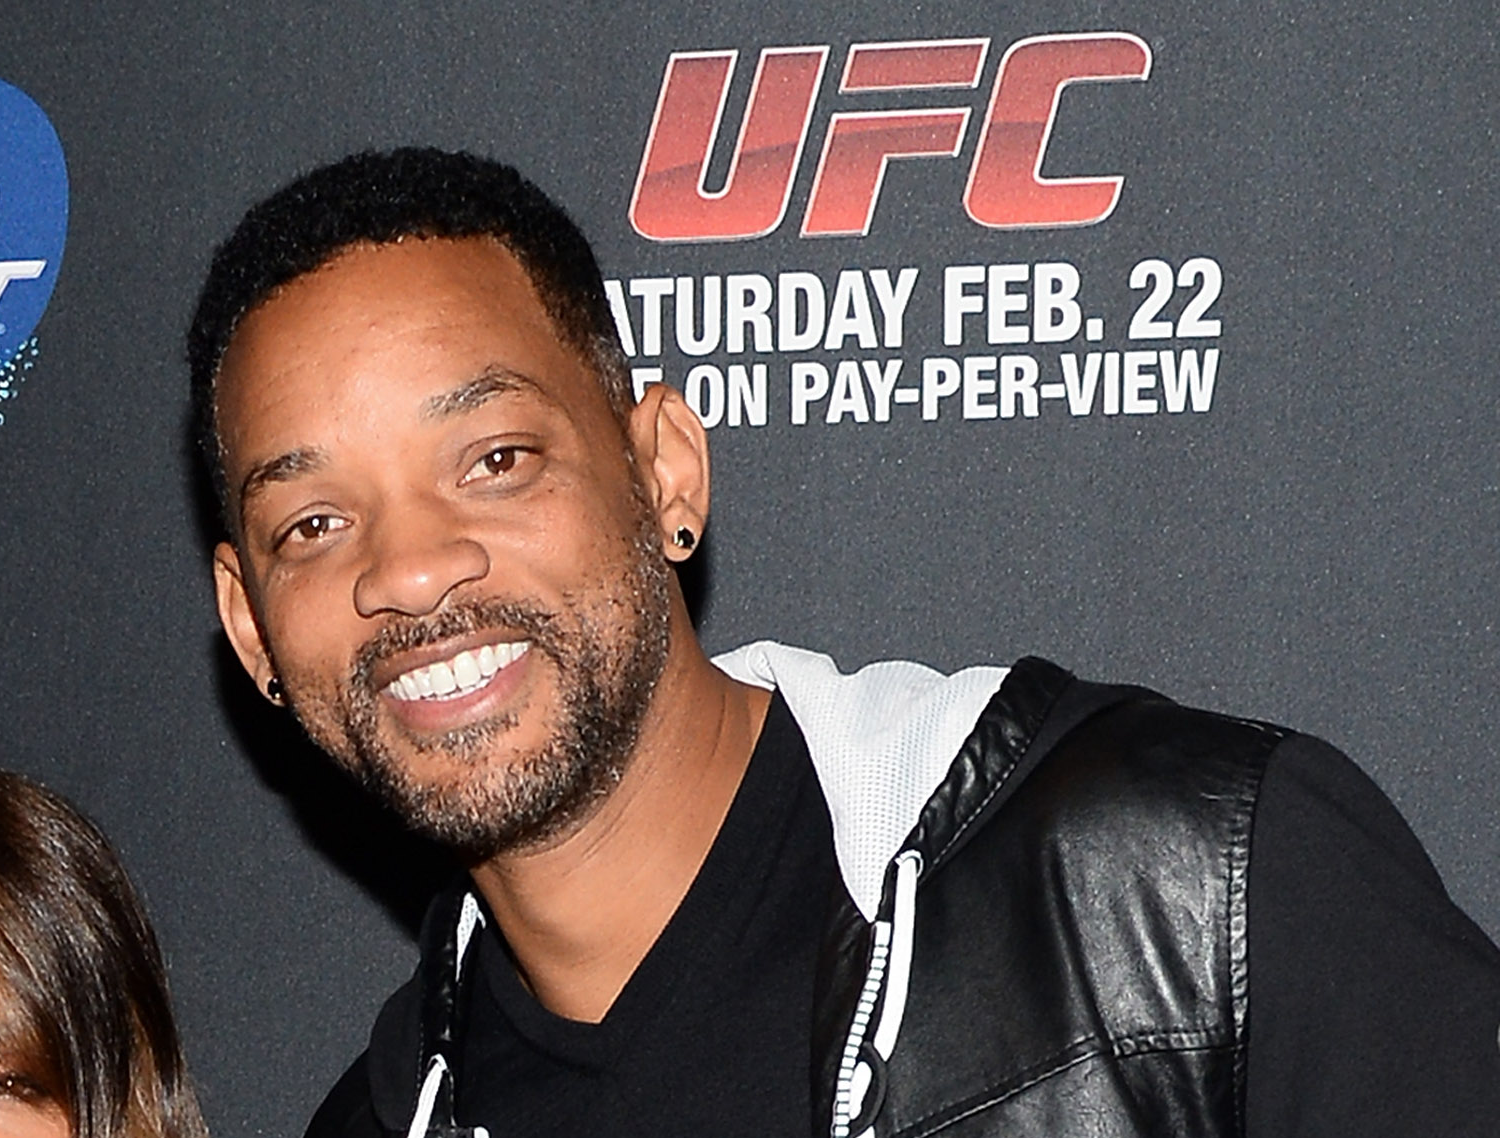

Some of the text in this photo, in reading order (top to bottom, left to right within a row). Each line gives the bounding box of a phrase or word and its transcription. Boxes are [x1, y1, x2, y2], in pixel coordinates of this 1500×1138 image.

[627, 30, 1153, 242] UFC
[943, 261, 1103, 345] FEB.
[1128, 257, 1222, 340] 22
[685, 363, 768, 429] ON
[791, 348, 1220, 425] PAY-PER-VIEW
